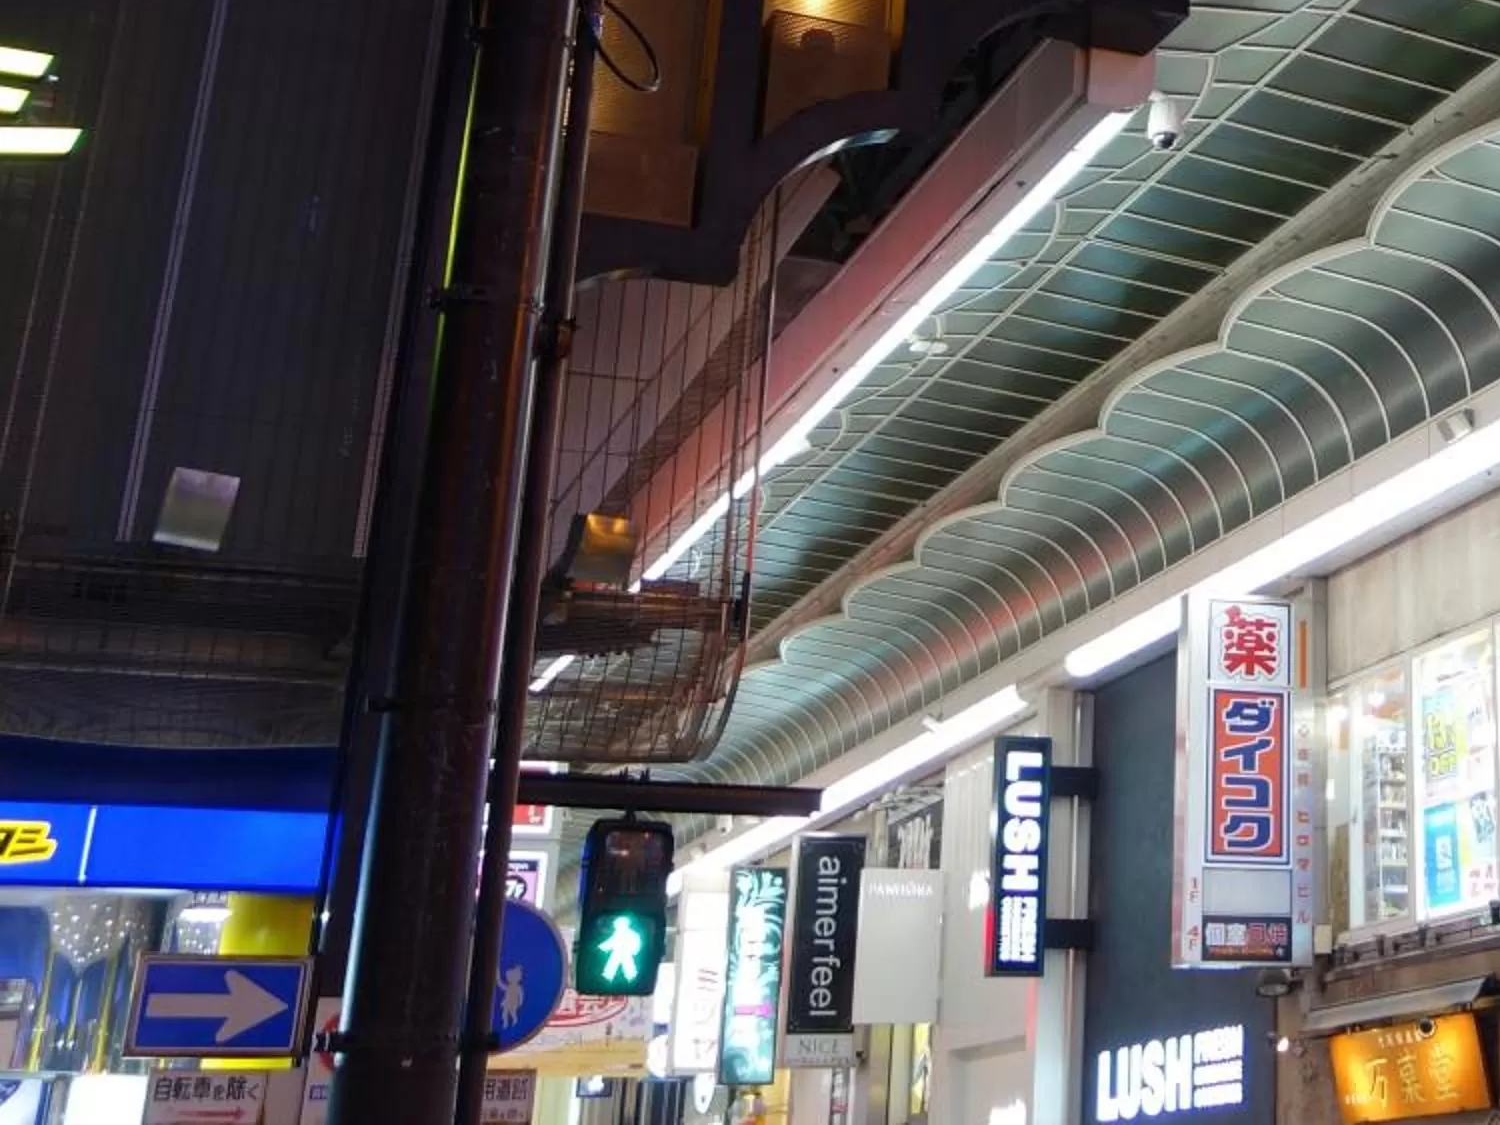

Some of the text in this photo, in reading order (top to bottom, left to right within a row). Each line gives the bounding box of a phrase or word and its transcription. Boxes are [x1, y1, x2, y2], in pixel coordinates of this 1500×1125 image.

[1223, 606, 1280, 676] 薬
[1222, 699, 1278, 852] ダイコク
[1001, 751, 1044, 891] LUSH
[153, 1075, 260, 1102] 自転車を除く
[1096, 1035, 1194, 1123] LUSH
